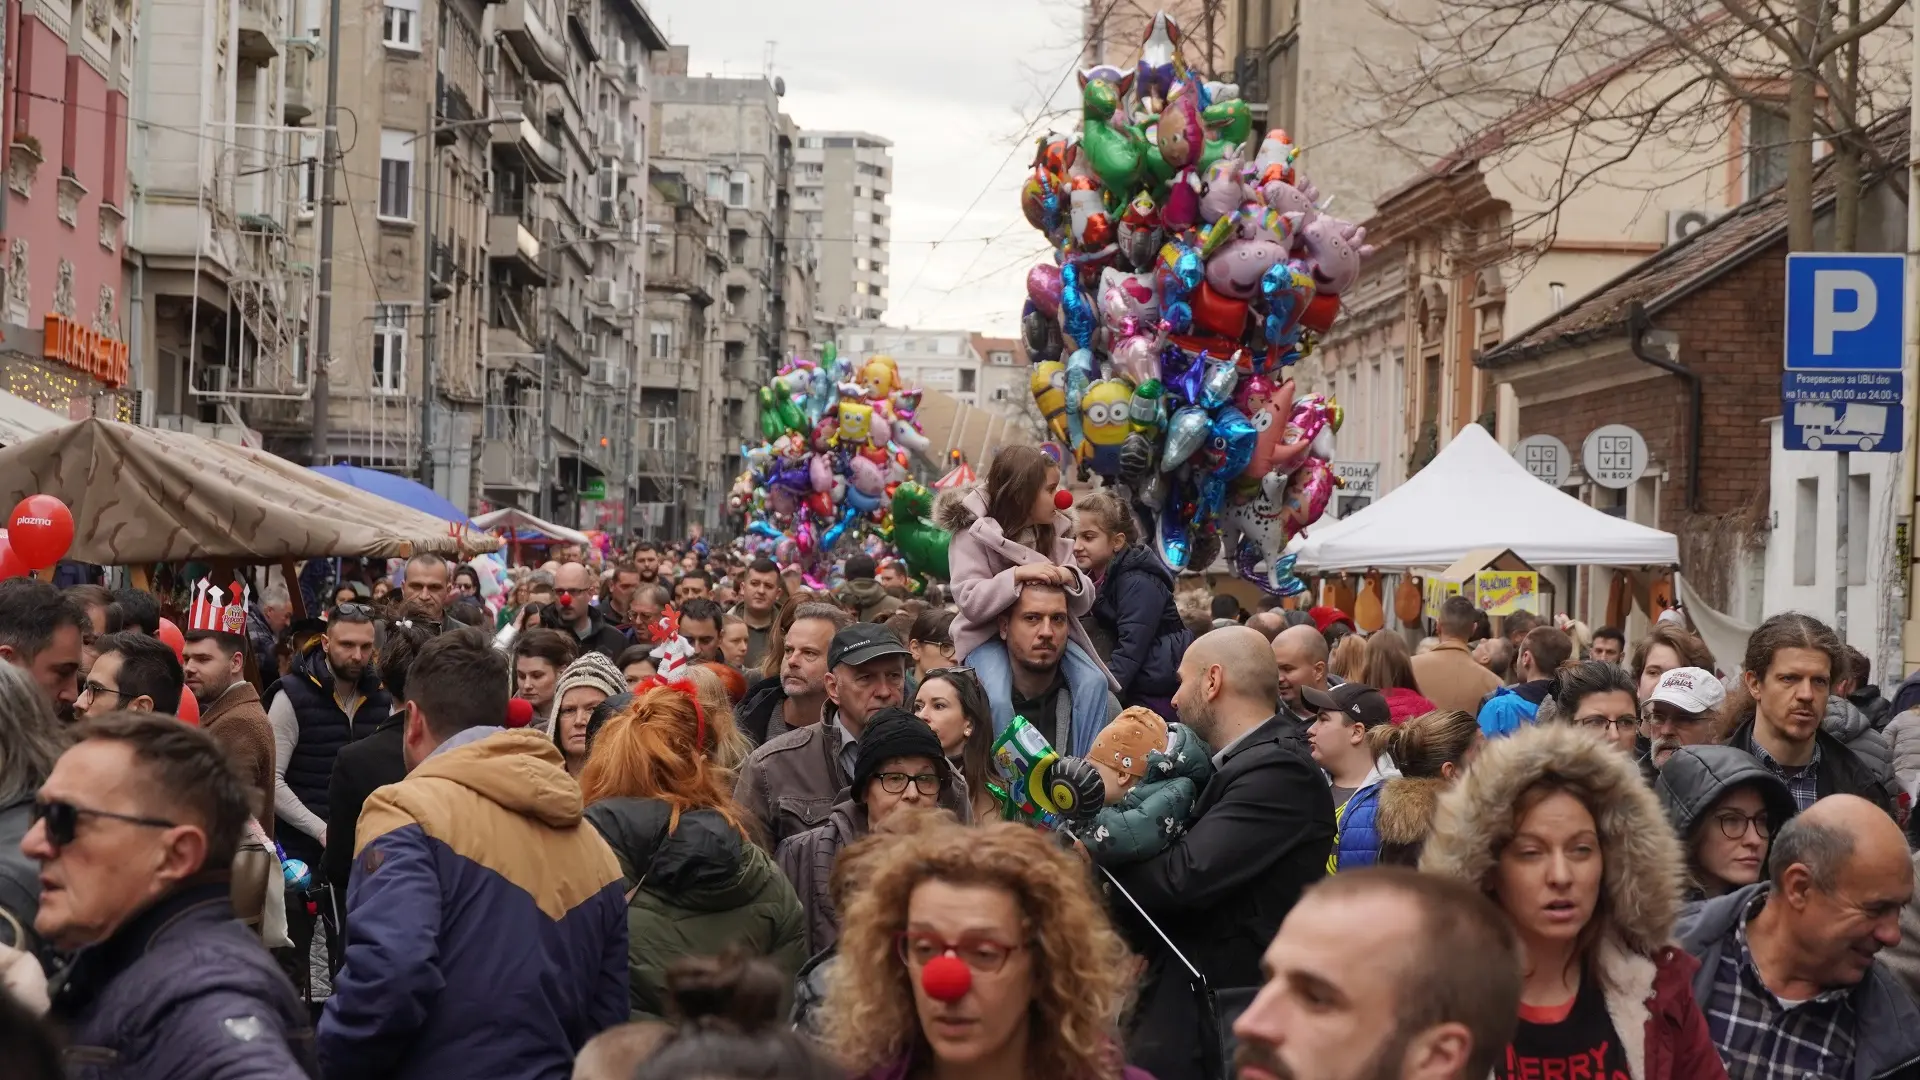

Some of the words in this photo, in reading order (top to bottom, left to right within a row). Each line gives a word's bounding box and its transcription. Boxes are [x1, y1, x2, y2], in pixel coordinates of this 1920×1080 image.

[1813, 270, 1878, 355] P
[1796, 373, 1845, 385] Резервисано
[1846, 376, 1856, 384] за
[1786, 391, 1795, 399] на
[1819, 391, 1830, 399] од
[1831, 389, 1855, 399] 00.00
[1856, 391, 1867, 399] до
[1868, 389, 1892, 399] 24.00
[1339, 466, 1370, 477] ЗОНА
[1611, 471, 1632, 479] BOX
[1344, 480, 1374, 492] КОЛЕ
[16, 515, 52, 527] plazma
